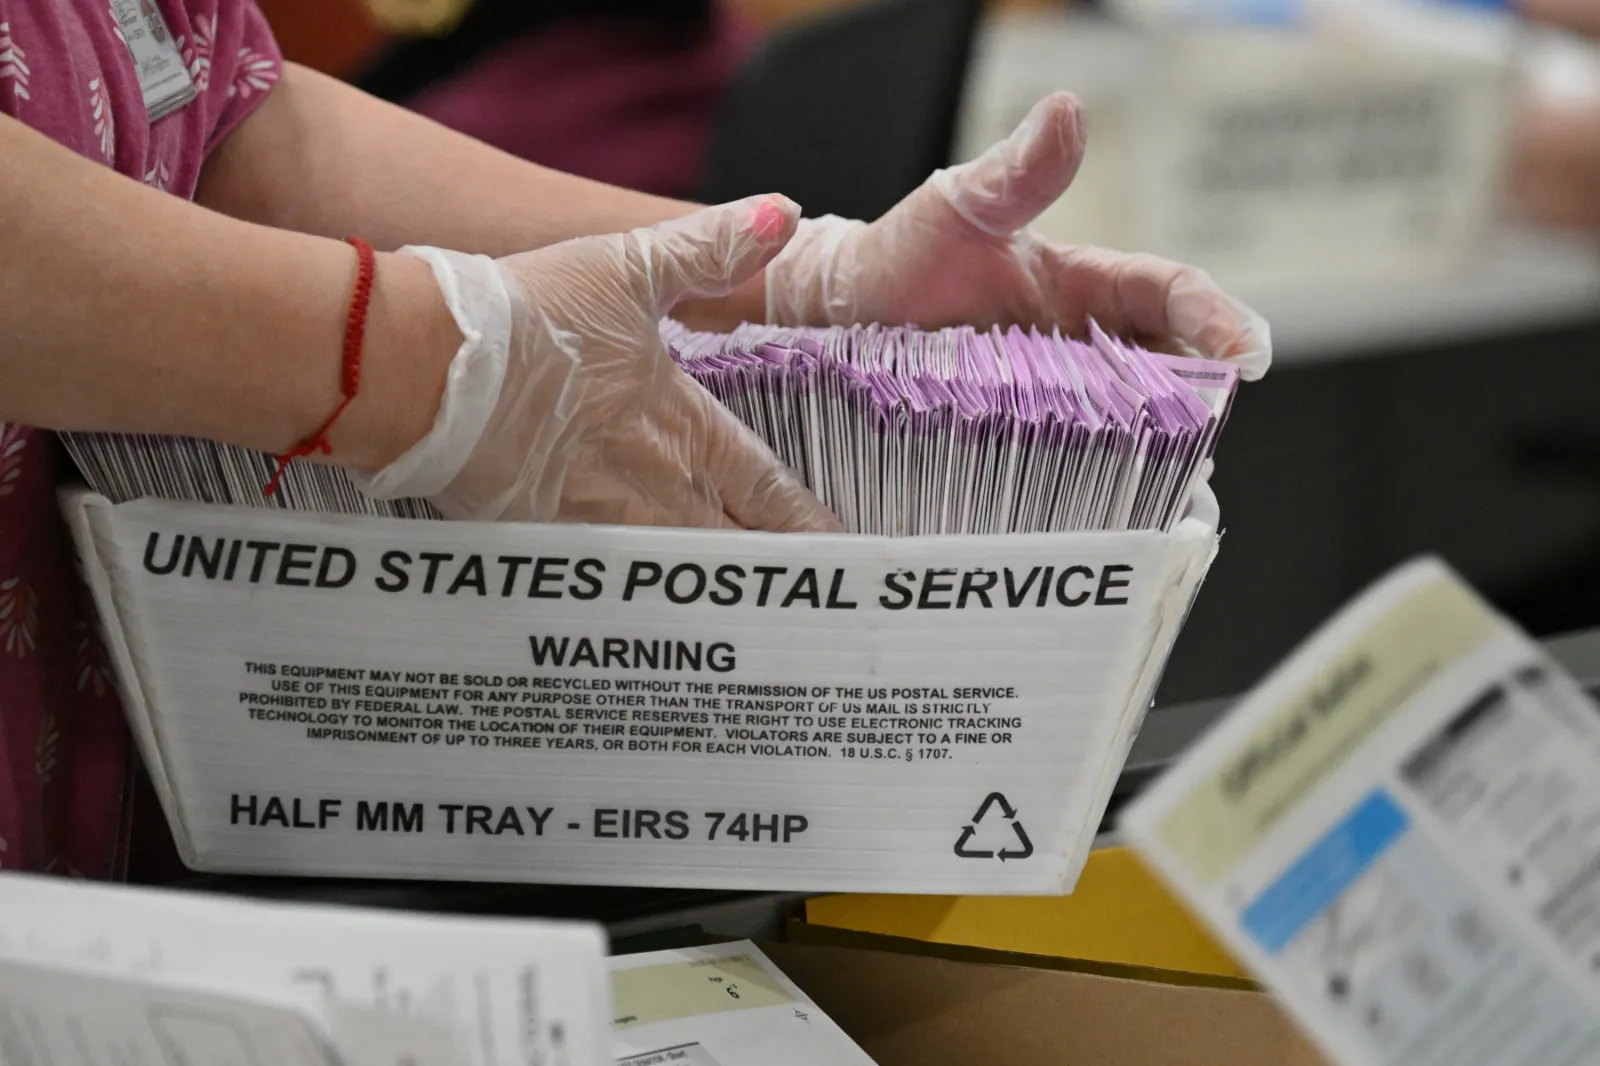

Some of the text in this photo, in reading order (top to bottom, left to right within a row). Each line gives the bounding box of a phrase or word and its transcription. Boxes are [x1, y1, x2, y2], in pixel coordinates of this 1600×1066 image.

[143, 532, 1133, 610] UNITED STATES POSTAL SERVICE
[529, 635, 736, 672] WARNING
[245, 662, 1018, 699] THIS EQUIPMENT MAY NOT BE SOLD OR RECYCLED WITHOUT THE PERMISSION OF THE US POSTAL SERVICE.
[272, 680, 991, 714] USE OF THIS EQUIPMENT FOR ANY PURPOSE OTHER THAN THE TRANSPORT OF US MAIL IS STRICTLY
[240, 692, 1021, 729] PROHIBITED BY FEDERAL LAW. THE POSTAL SERVICE RESERVES THE RIGHT TO USE ELECTRONIC TRACKING
[248, 708, 1012, 743] TECHNOLOGY TO MONITOR THE LOCATION OF THEIR EQUIPMENT. VIOLATORS ARE SUBJECT TO A FINE OR
[307, 728, 417, 743] IMPRISONMENT
[422, 733, 440, 744] OF
[446, 735, 465, 745] UP
[470, 735, 489, 746] TO
[494, 736, 540, 748] THREE
[546, 738, 598, 750] YEARS,
[603, 740, 623, 750] OR
[629, 740, 667, 751] BOTH
[673, 742, 701, 752] FOR
[706, 743, 745, 754] EACH
[751, 744, 831, 757] VIOLATION.
[841, 748, 855, 758] 18
[860, 748, 900, 759] U.S.C.
[919, 749, 952, 759] 1707.
[230, 794, 340, 829] HALF
[356, 802, 423, 833] MM
[438, 803, 553, 836] TRAY
[593, 809, 689, 840] EIRS
[704, 812, 808, 843] 74HP
